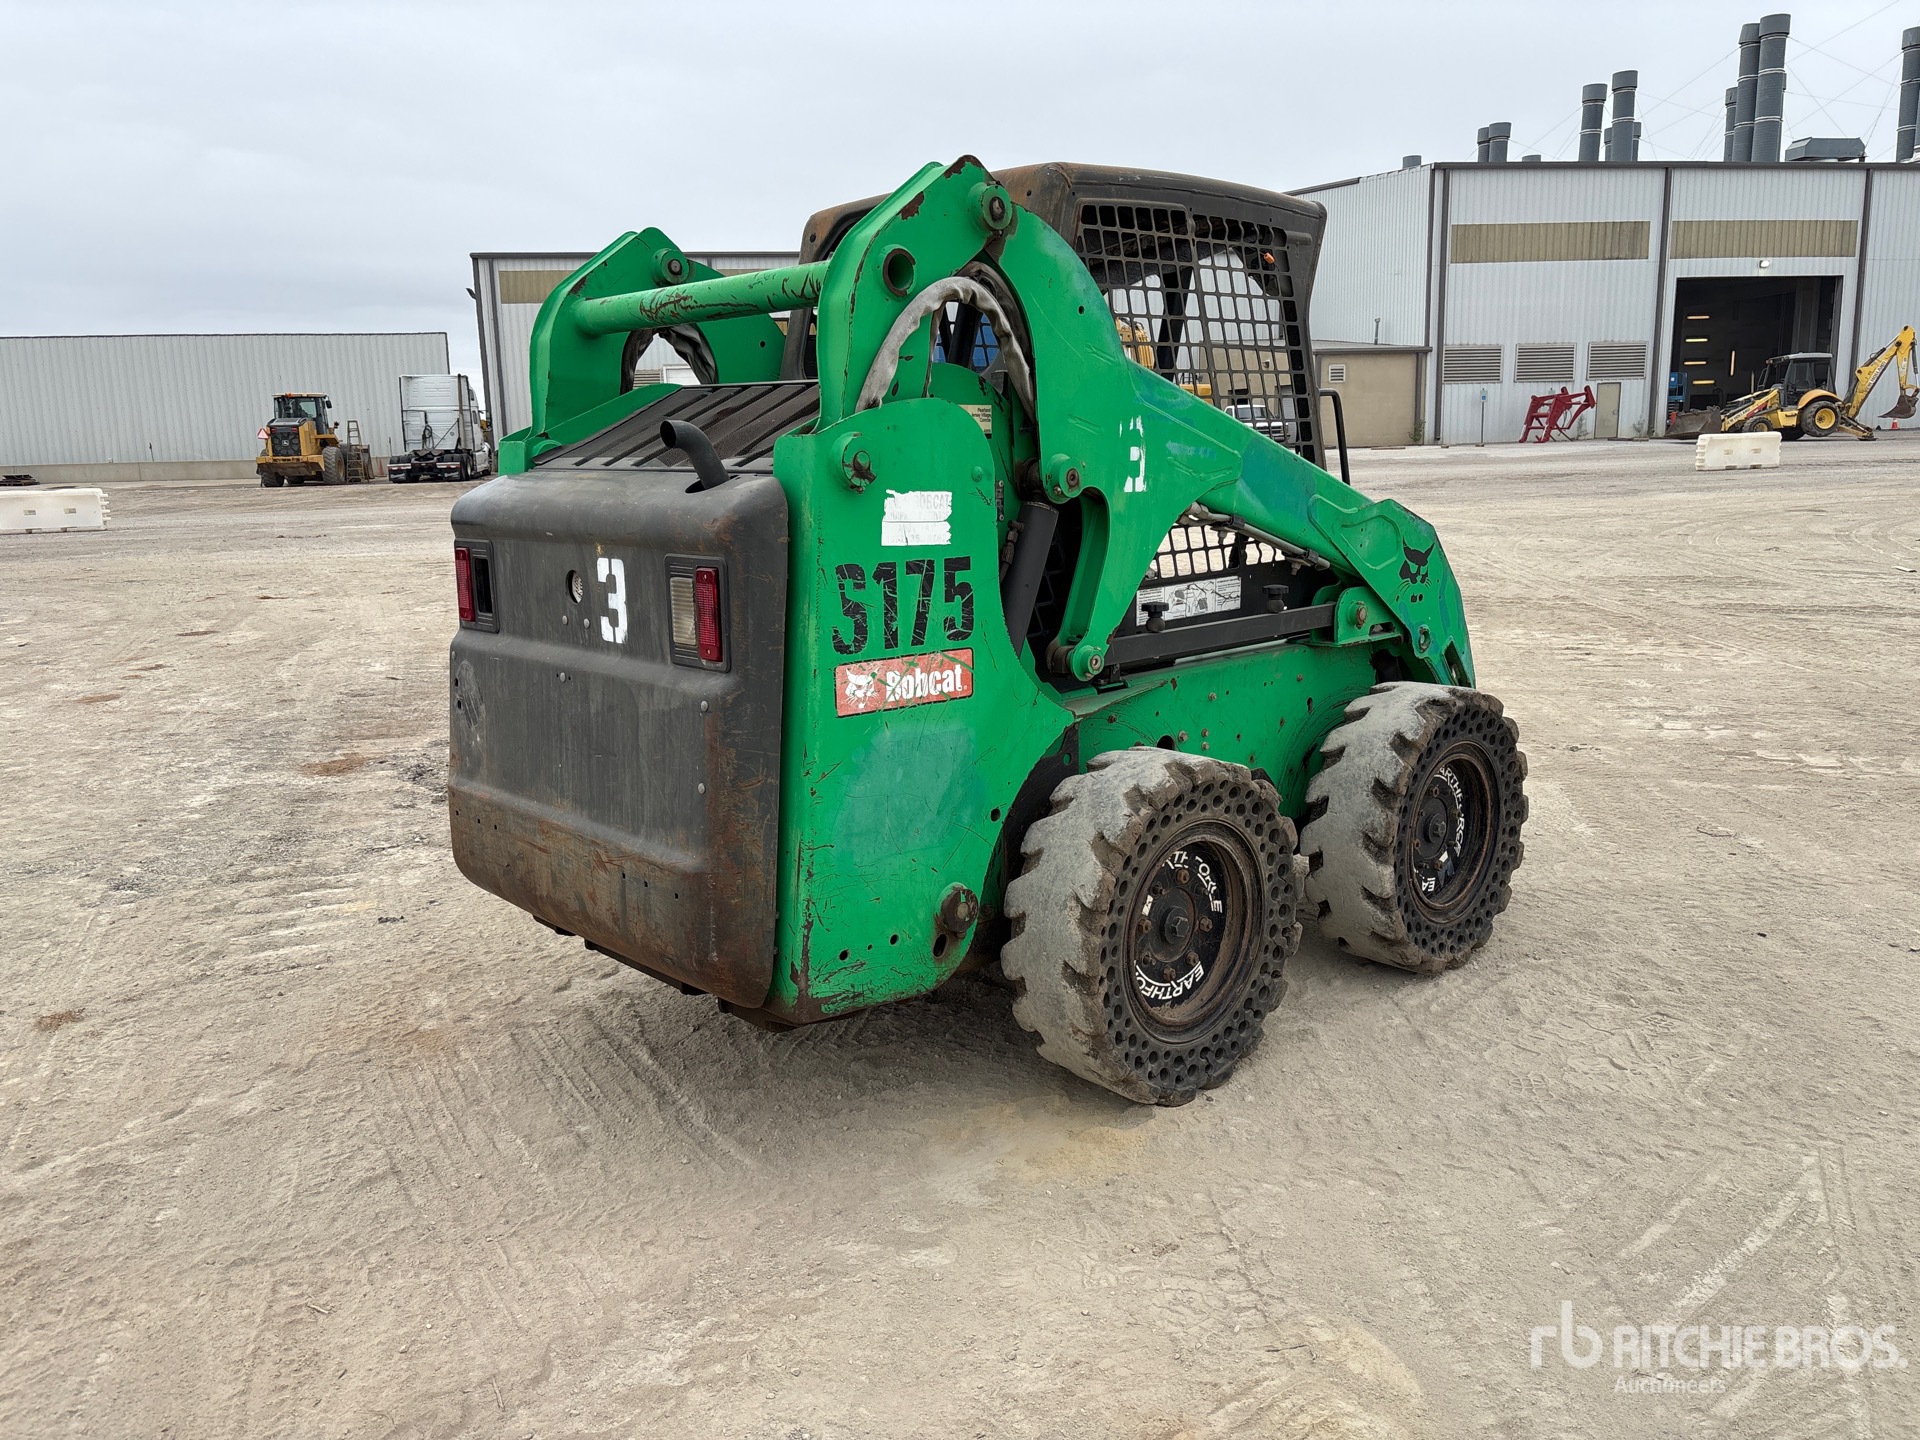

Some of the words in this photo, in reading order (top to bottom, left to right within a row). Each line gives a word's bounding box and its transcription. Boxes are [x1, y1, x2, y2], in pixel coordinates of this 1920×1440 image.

[597, 557, 628, 643] 3
[832, 556, 974, 655] S175
[886, 664, 963, 702] Bobcat
